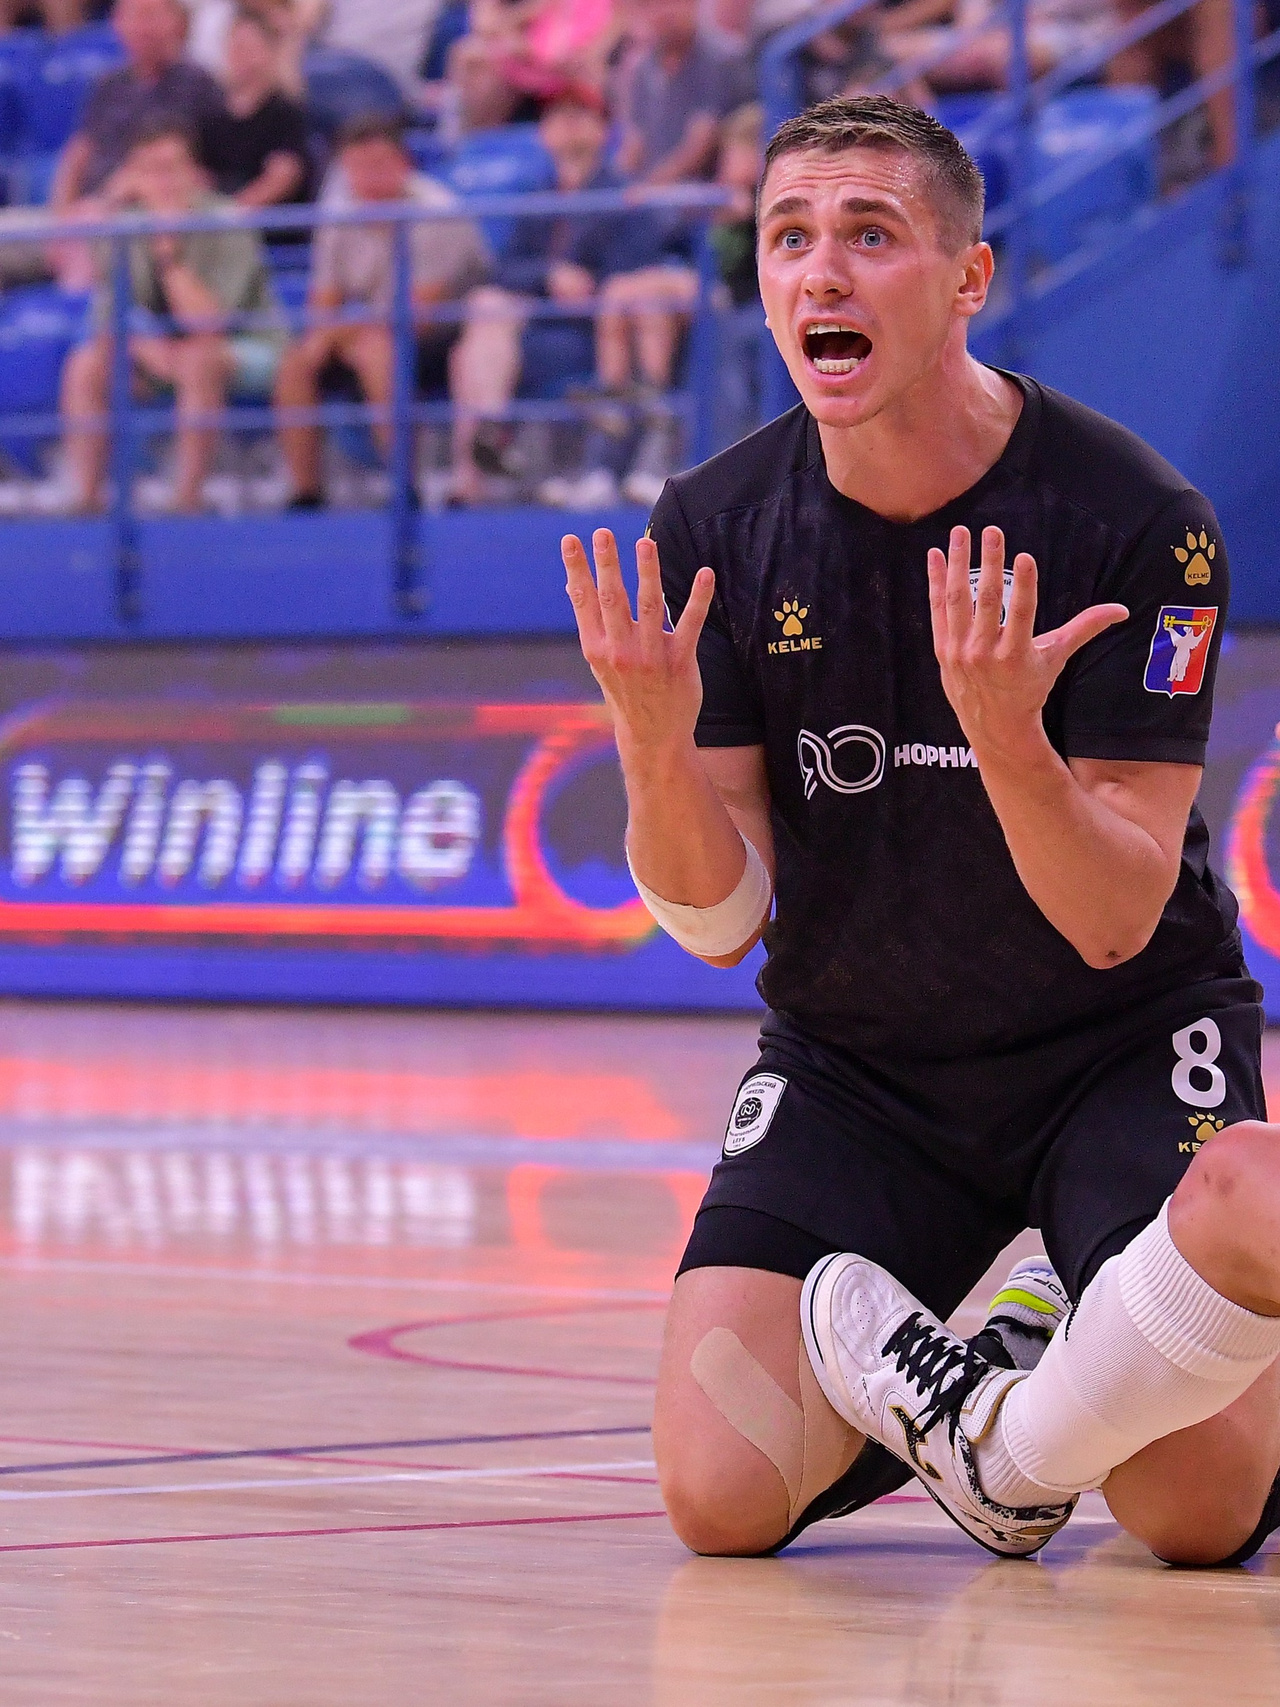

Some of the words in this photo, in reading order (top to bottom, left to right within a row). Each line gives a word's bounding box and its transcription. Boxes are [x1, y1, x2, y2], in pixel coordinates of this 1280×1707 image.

[768, 637, 823, 655] KELME
[894, 743, 979, 768] НОРНИ
[10, 760, 482, 890] winline
[1171, 1017, 1226, 1108] 8
